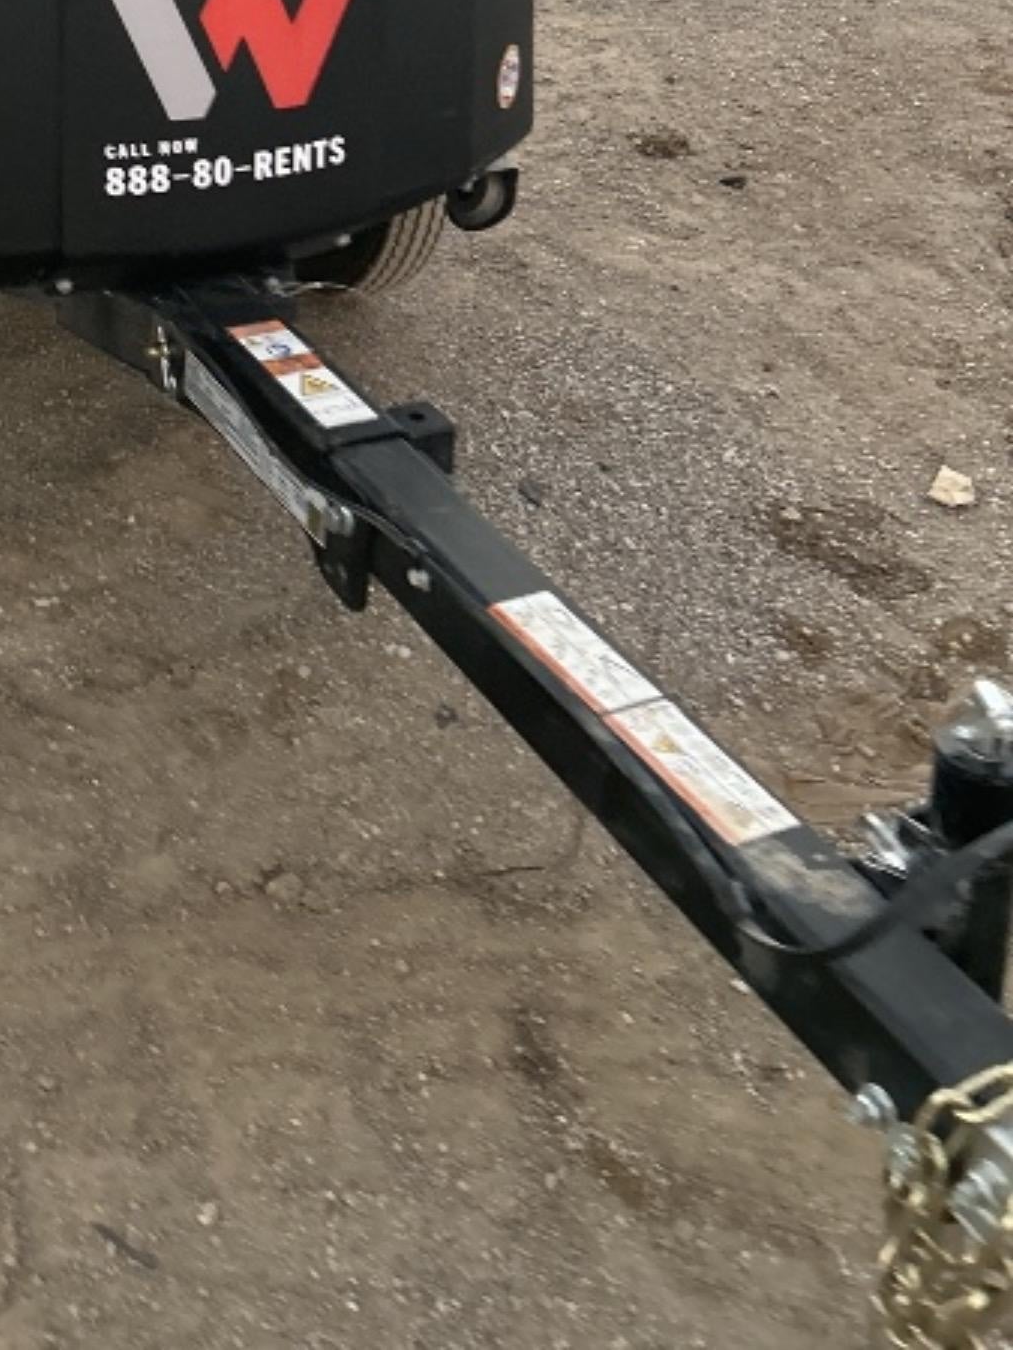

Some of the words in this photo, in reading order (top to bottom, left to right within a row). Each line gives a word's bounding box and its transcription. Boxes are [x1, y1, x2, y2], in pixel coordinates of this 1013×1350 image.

[102, 142, 152, 161] CALL
[156, 137, 199, 157] NOW
[104, 133, 347, 198] 888-80-RENTS
